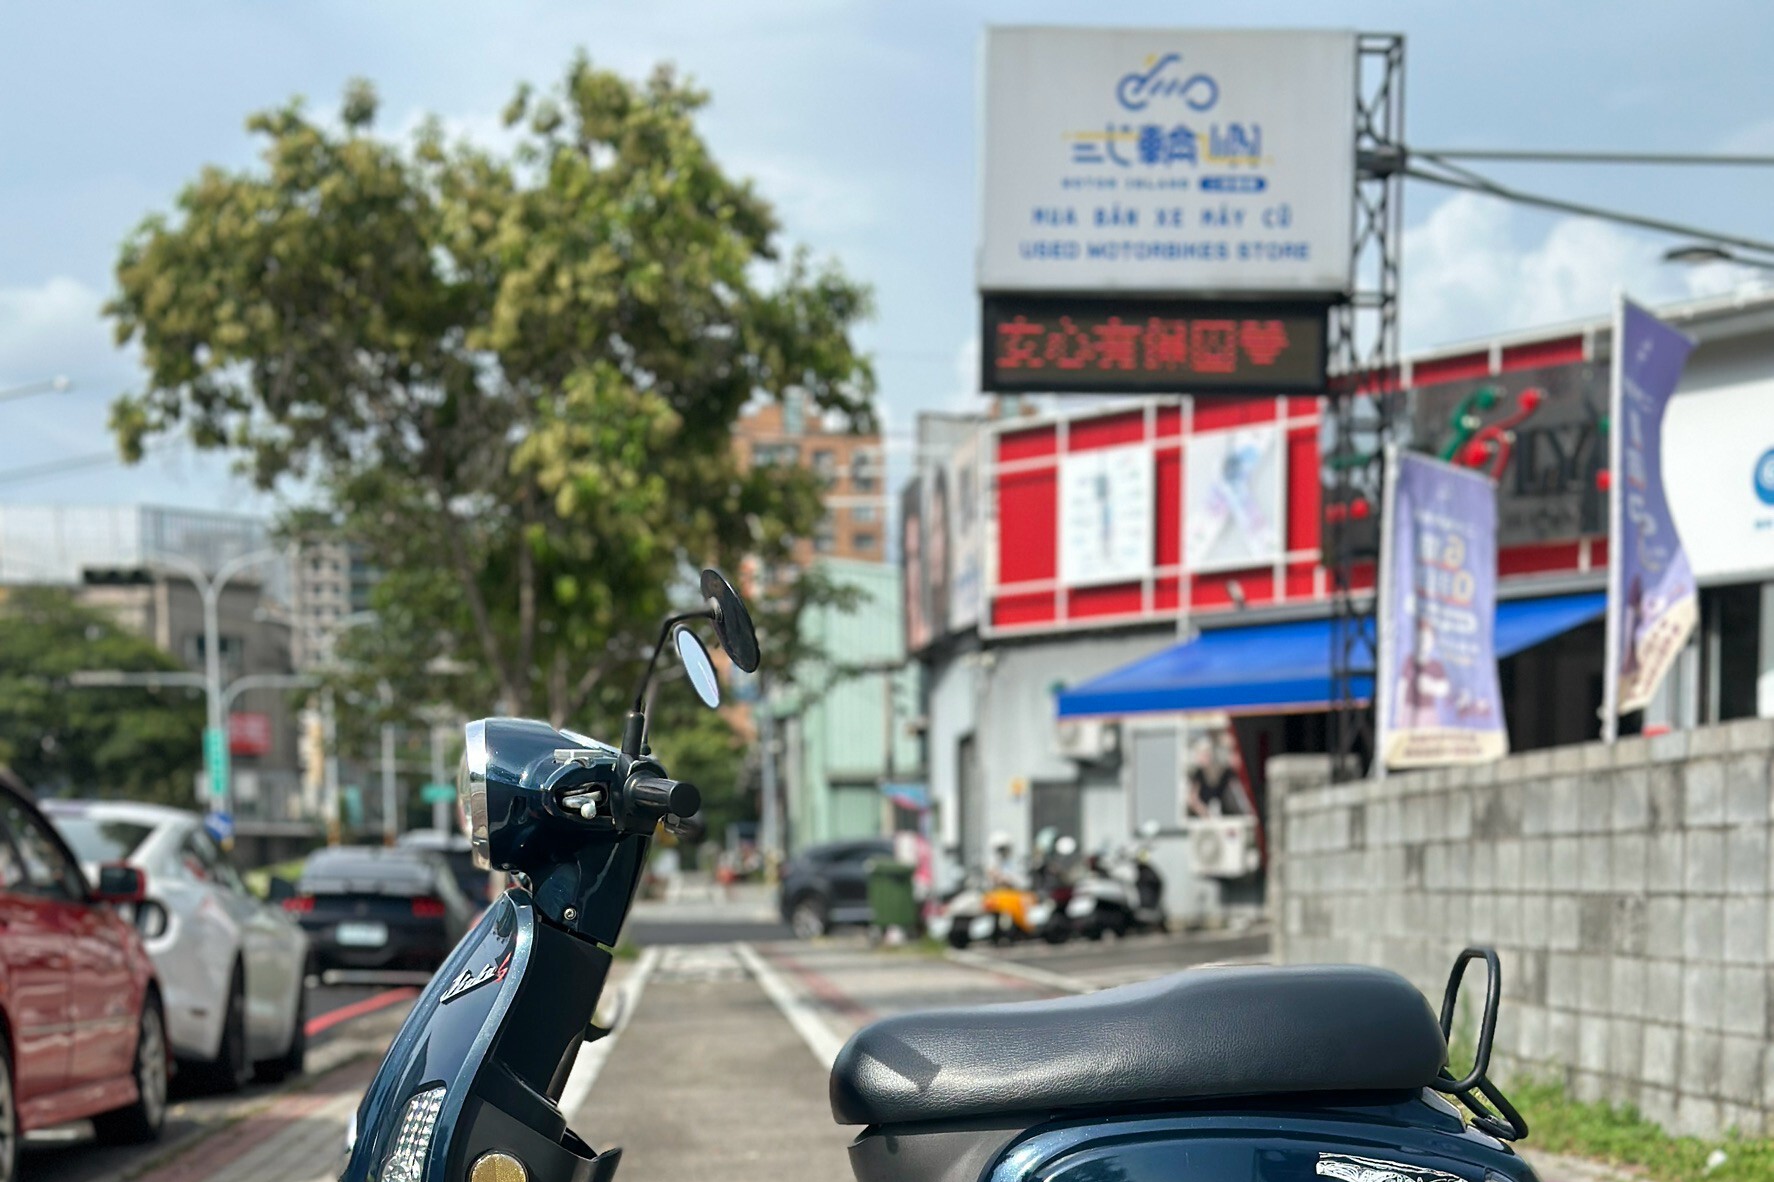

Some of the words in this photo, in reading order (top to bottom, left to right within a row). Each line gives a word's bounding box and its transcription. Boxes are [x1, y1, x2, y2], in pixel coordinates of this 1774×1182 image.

[1031, 206, 1078, 228] MUA
[1154, 206, 1184, 228] XE
[1018, 240, 1080, 261] USED
[1086, 240, 1230, 261] MOTORBIKES
[1236, 240, 1311, 261] STORE
